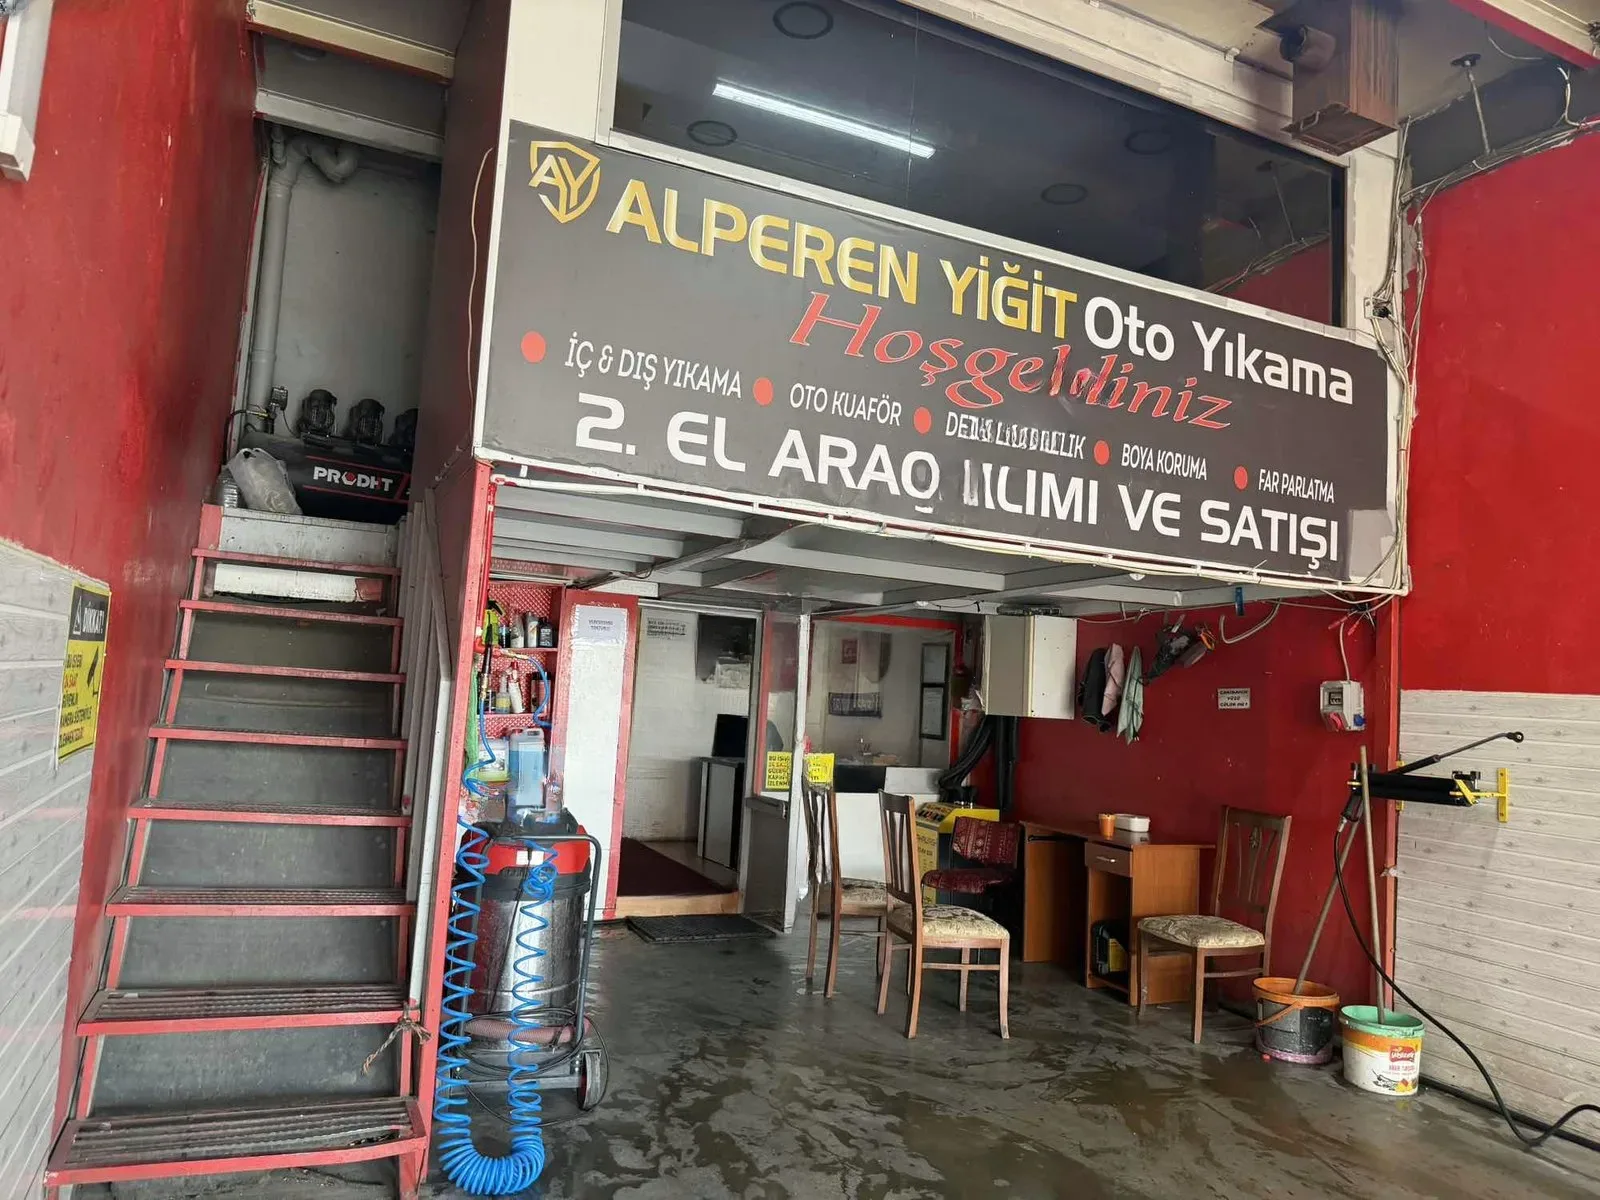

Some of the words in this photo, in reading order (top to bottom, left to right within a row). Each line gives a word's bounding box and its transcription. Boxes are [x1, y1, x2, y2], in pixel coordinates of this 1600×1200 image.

[605, 178, 919, 305] ALPEREN
[939, 255, 1078, 339] YİĞİT
[1084, 296, 1175, 361] Oto
[1192, 320, 1354, 405] Yıkama
[564, 331, 592, 378] İÇ
[598, 343, 614, 373] &
[617, 348, 659, 391] DIŞ
[663, 357, 742, 400] YIKAMA
[789, 382, 828, 412] OTO
[830, 393, 903, 427] KUAFÖR
[575, 392, 637, 456] 2.
[666, 410, 747, 473] EL
[1117, 484, 1182, 538] VE
[1200, 499, 1339, 571] SATIŞI
[1121, 443, 1155, 472] BOYA
[1156, 449, 1208, 482] KORUMA
[1258, 468, 1280, 493] FAR
[1281, 472, 1335, 504] PARLATMA
